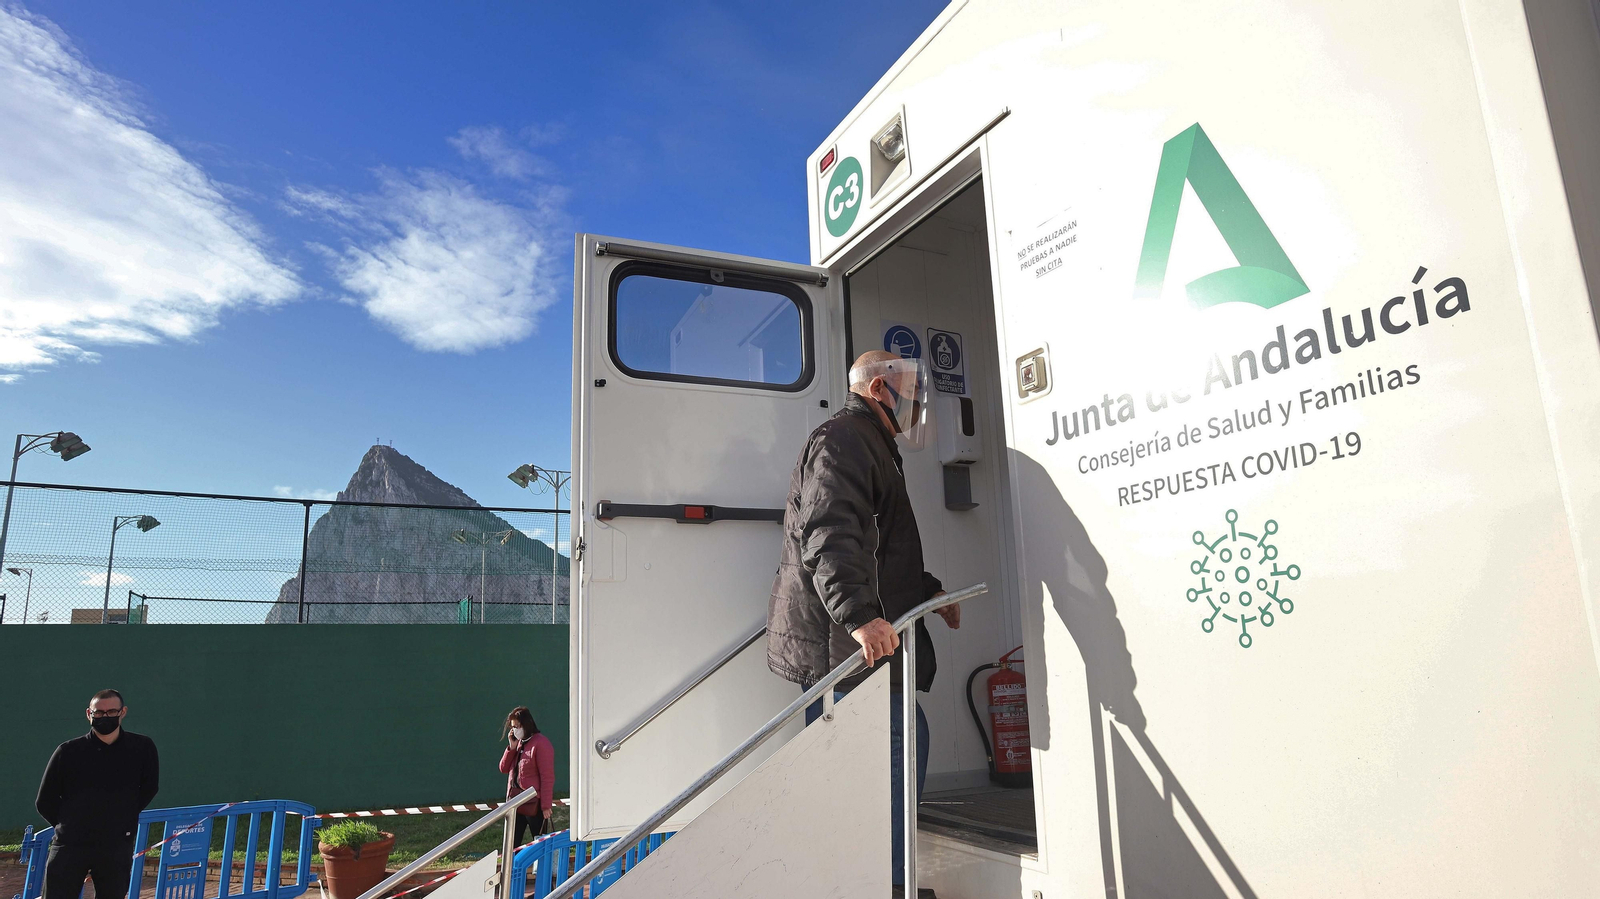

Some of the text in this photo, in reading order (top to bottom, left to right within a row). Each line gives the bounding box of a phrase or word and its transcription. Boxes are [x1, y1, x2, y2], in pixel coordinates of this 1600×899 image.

[828, 172, 860, 221] C3
[1017, 220, 1077, 259] NO SE REALIZARÁN
[1020, 234, 1077, 271] PRUEBAS A NADIE
[1036, 257, 1062, 277] SIN CITA
[1045, 389, 1136, 446] Junta
[1203, 266, 1471, 395] Andalucía
[1077, 363, 1421, 475] Consejería de Salud y Familias
[1117, 431, 1362, 507] RESPUESTA COVID-19
